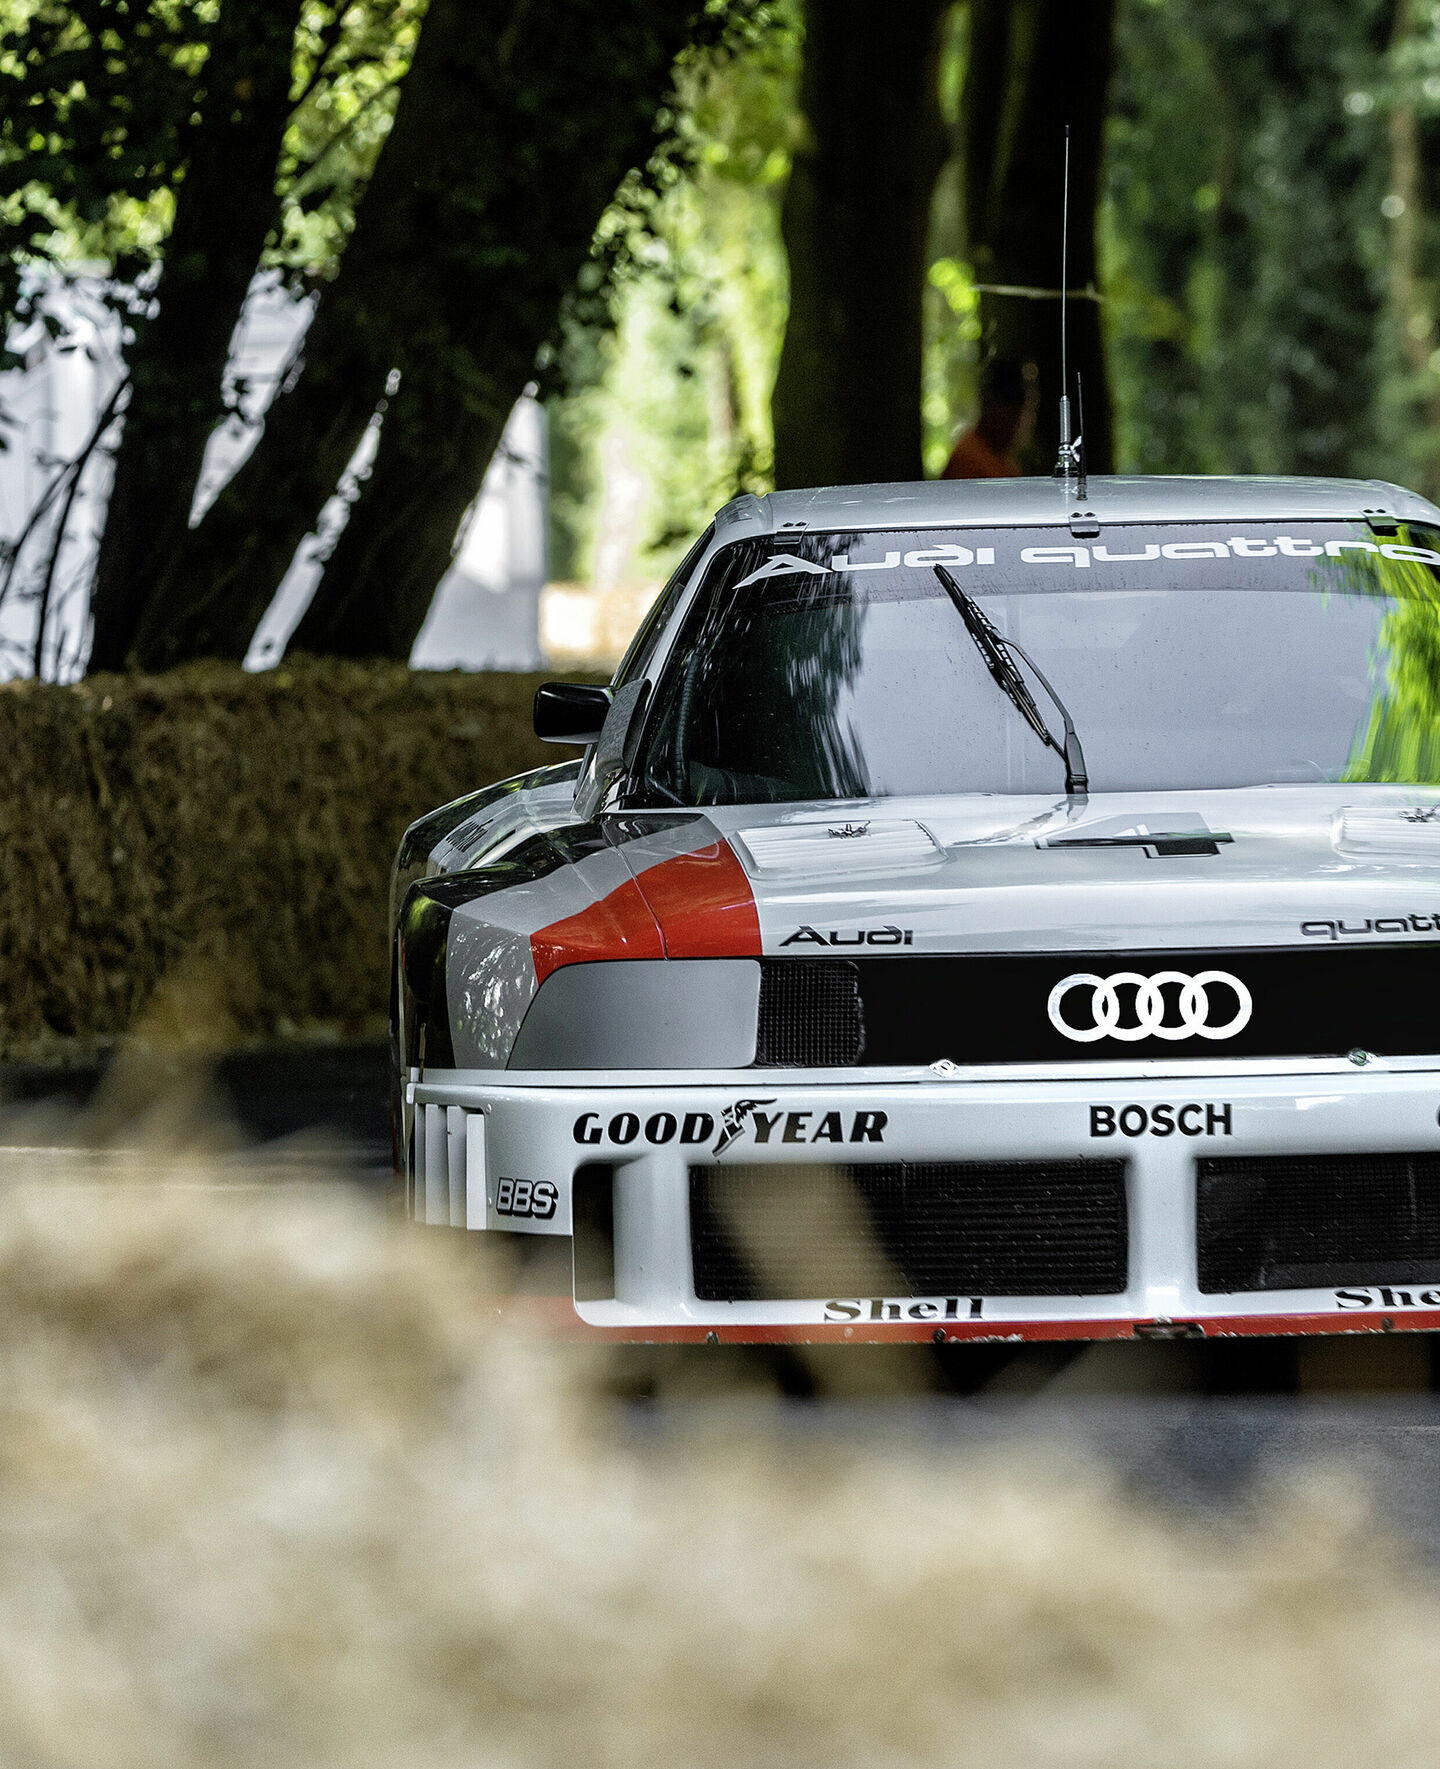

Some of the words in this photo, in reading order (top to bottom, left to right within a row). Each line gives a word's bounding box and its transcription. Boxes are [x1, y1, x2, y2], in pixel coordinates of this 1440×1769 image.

[733, 544, 995, 589] Audi
[779, 925, 914, 946] Audi
[1089, 1104, 1232, 1137] BOSCH
[496, 1177, 558, 1219] BBS
[823, 1297, 985, 1322] Shell
